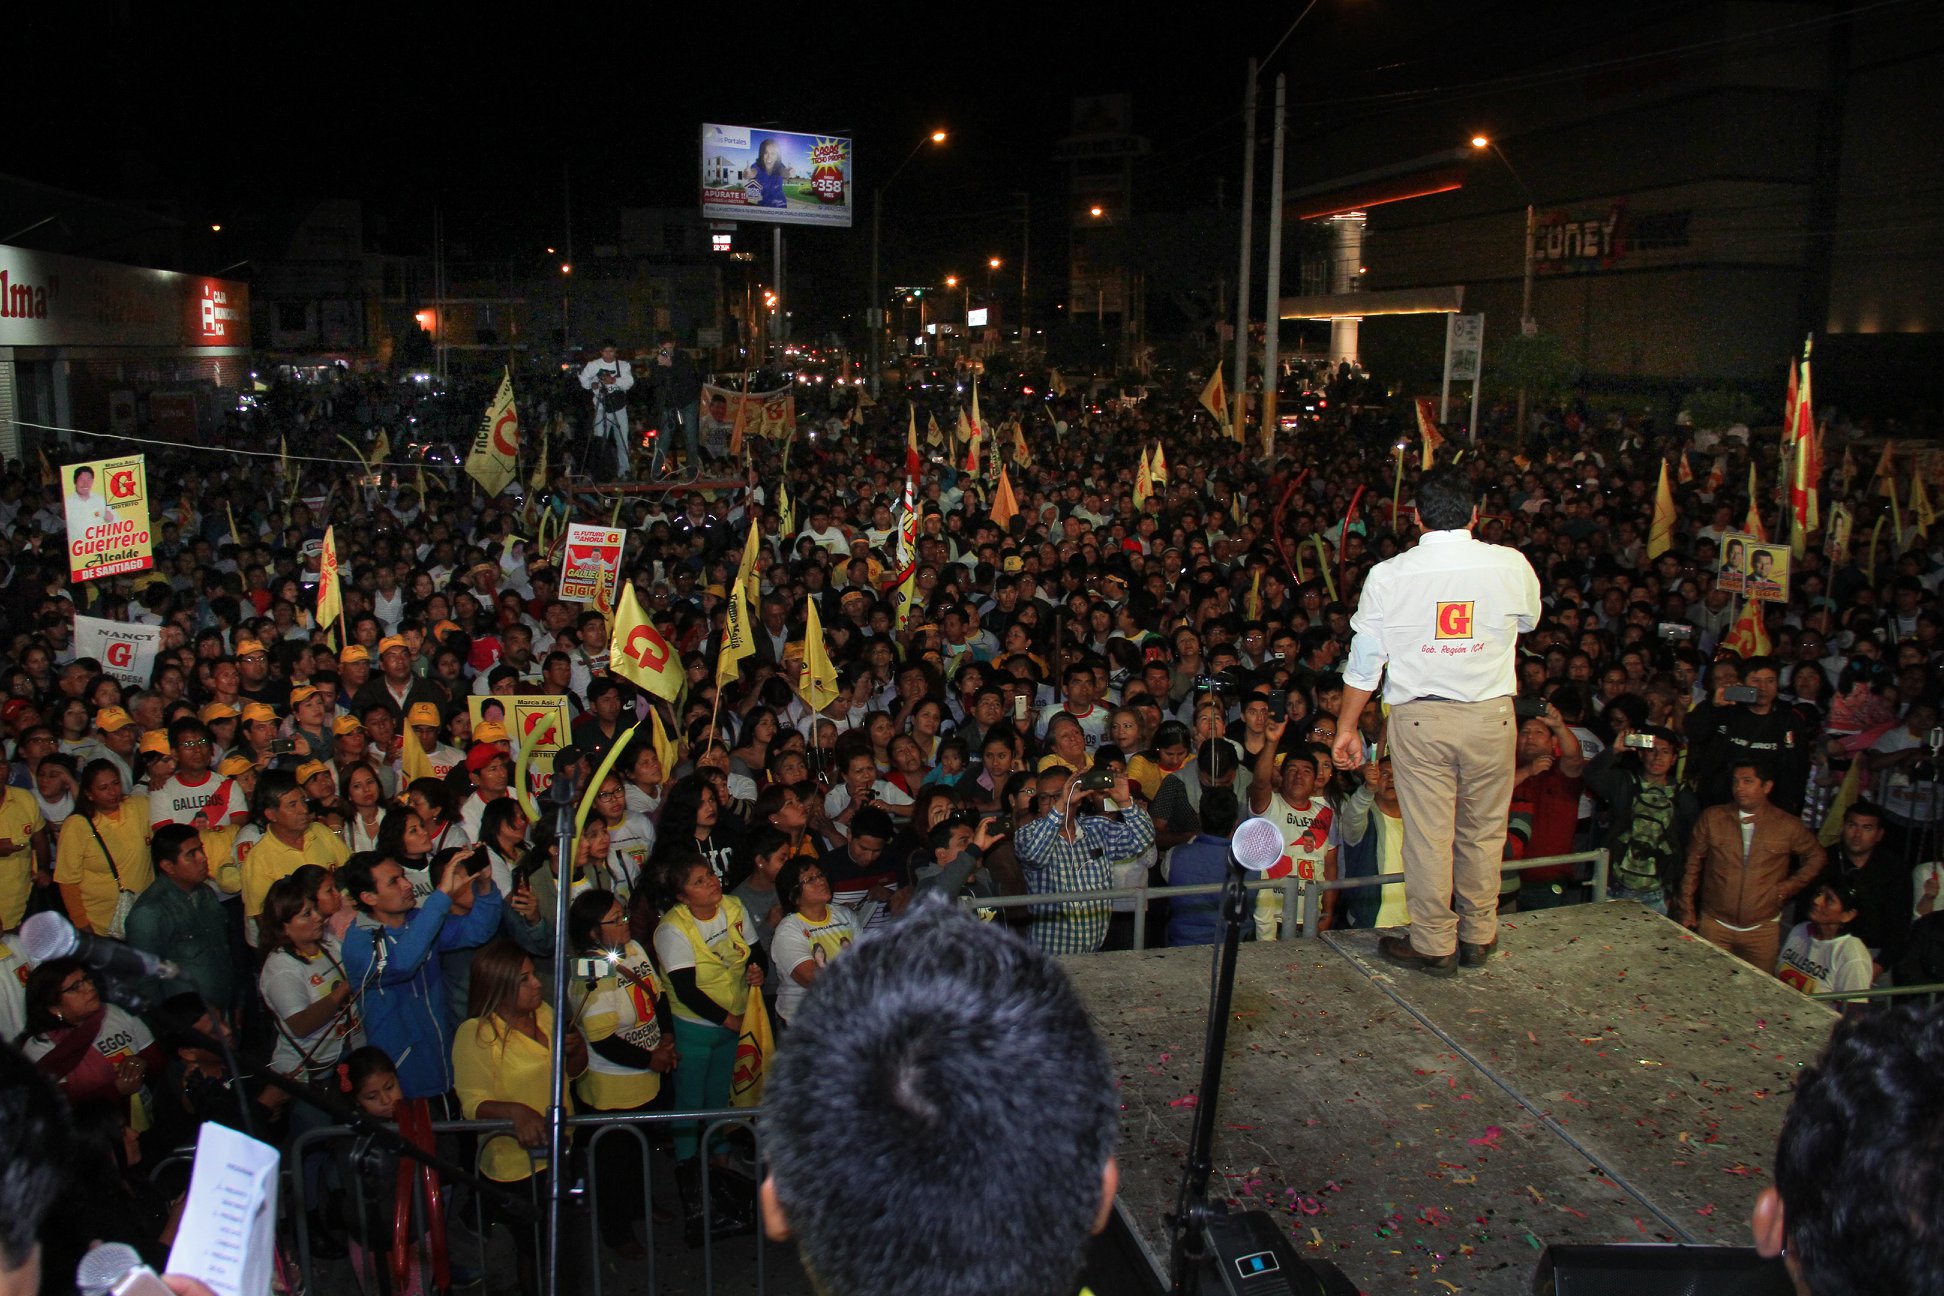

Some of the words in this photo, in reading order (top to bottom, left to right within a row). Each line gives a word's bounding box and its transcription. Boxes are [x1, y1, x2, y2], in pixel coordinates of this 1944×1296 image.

[724, 137, 746, 146] Portales
[814, 144, 839, 157] CASAS
[110, 471, 136, 498] G
[85, 519, 134, 540] CHINO
[607, 533, 619, 543] G
[72, 530, 149, 557] Guerrero
[85, 549, 140, 568] Alcalde
[81, 567, 95, 580] DE
[94, 559, 144, 578] SANTIAGO
[1440, 603, 1470, 635] G
[98, 629, 155, 642] NANCY
[107, 642, 132, 667] G
[1421, 644, 1437, 653] Gob.
[1441, 643, 1467, 656] Región
[1470, 642, 1485, 653] ICA
[173, 793, 224, 811] GALLEGOS
[1299, 860, 1315, 879] G
